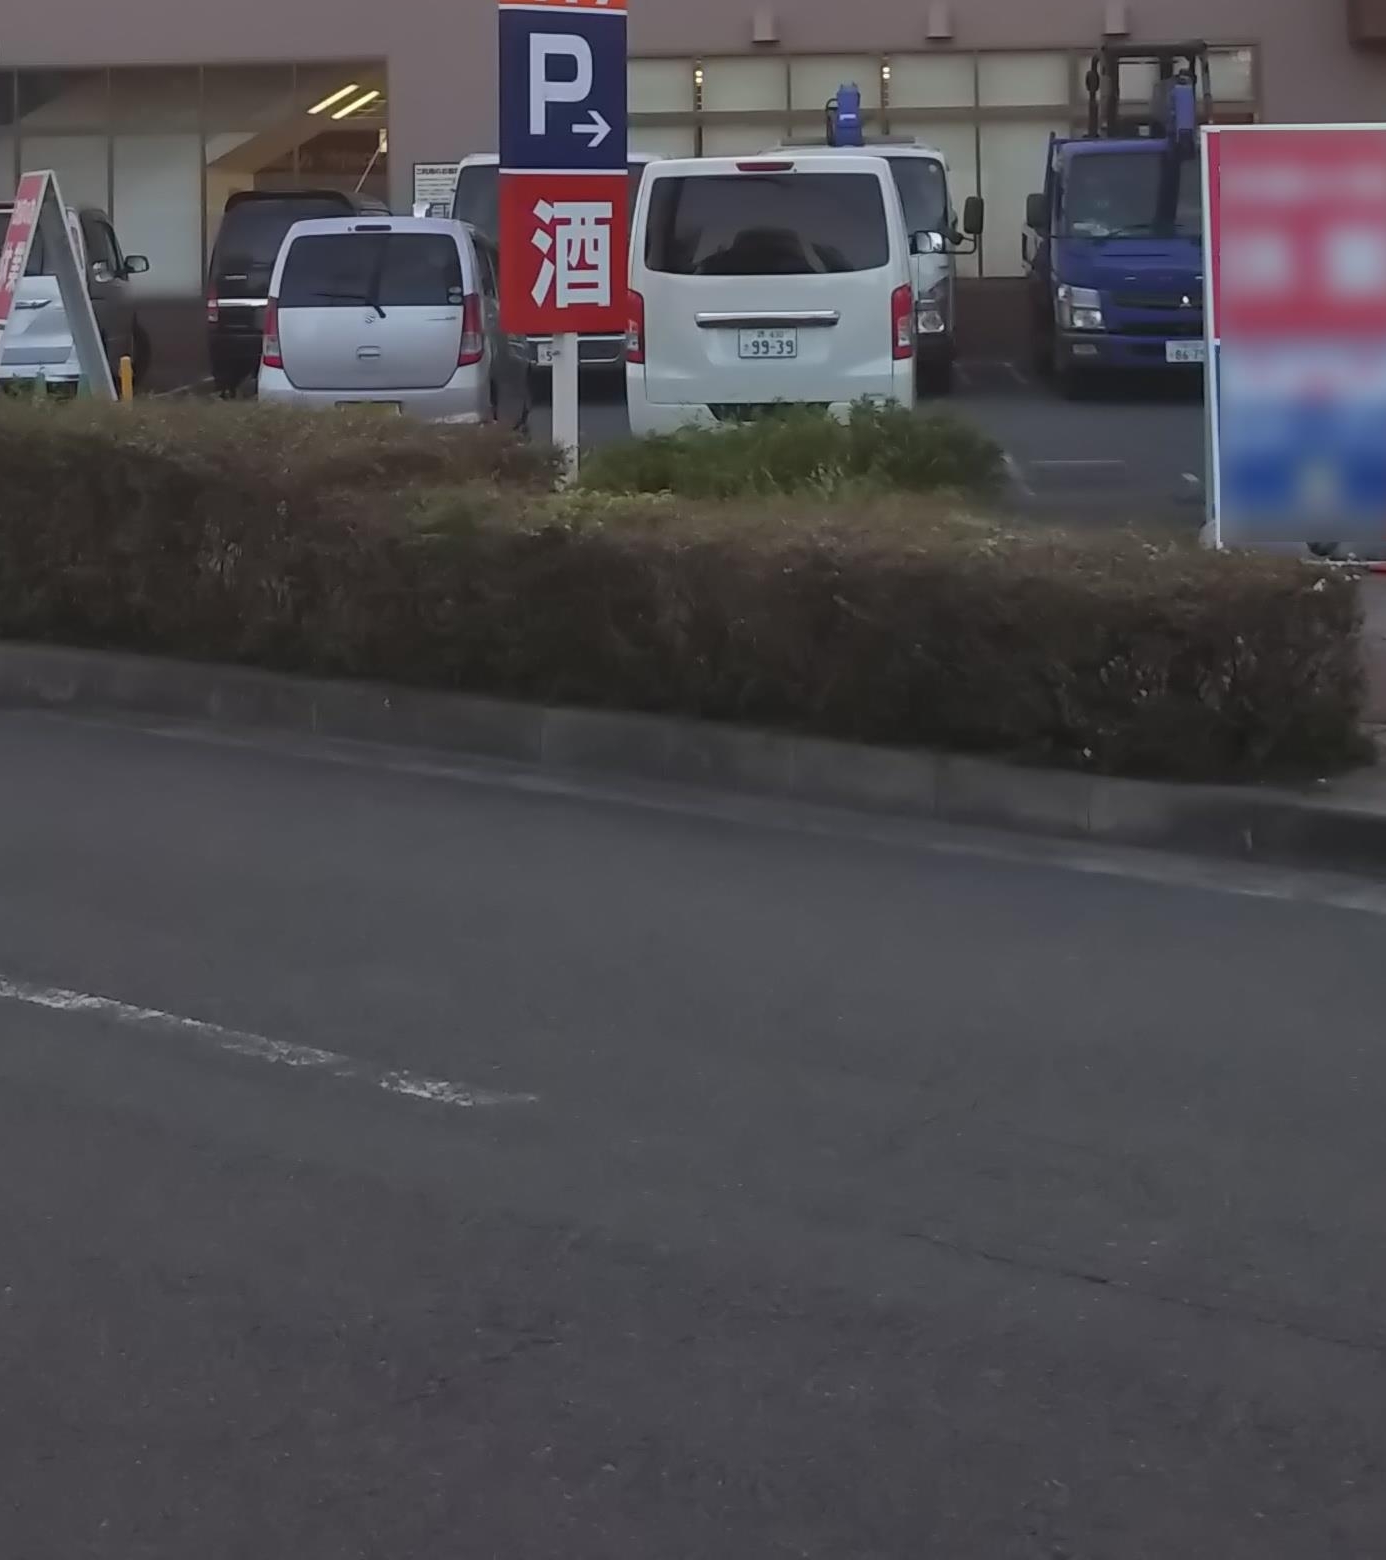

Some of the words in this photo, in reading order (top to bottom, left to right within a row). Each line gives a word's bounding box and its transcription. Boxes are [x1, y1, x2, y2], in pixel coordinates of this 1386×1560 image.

[529, 32, 593, 136] P
[531, 199, 613, 309] 酒
[751, 339, 794, 355] 99-39
